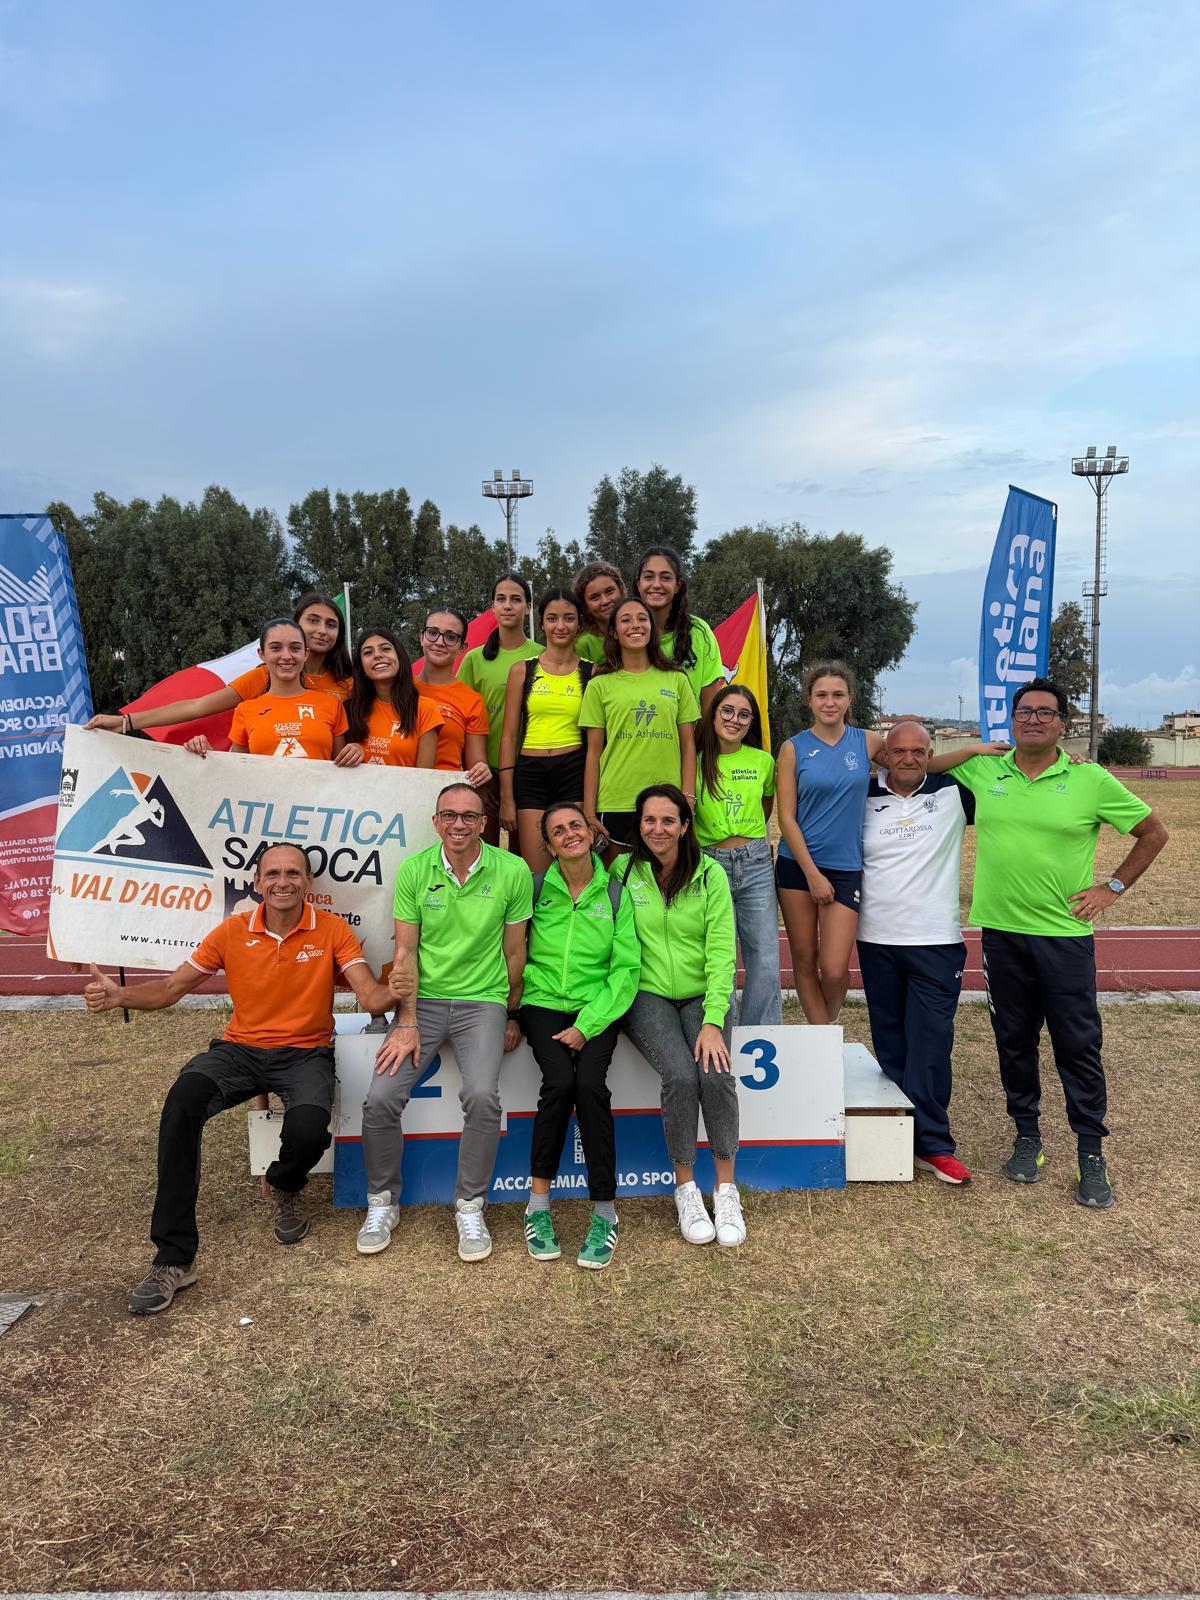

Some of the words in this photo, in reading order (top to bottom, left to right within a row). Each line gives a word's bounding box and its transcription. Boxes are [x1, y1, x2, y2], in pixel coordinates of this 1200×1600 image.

[1006, 538, 1047, 683] liana
[208, 798, 407, 847] ATLETICA
[879, 824, 933, 836] GROTTAROSSA
[222, 836, 382, 885] SAOCA
[70, 872, 114, 902] VAL
[118, 878, 213, 912] D'AGRÒ
[409, 1052, 442, 1098] 2
[739, 1038, 780, 1090] 3
[493, 1174, 588, 1191] ACCAEMIA
